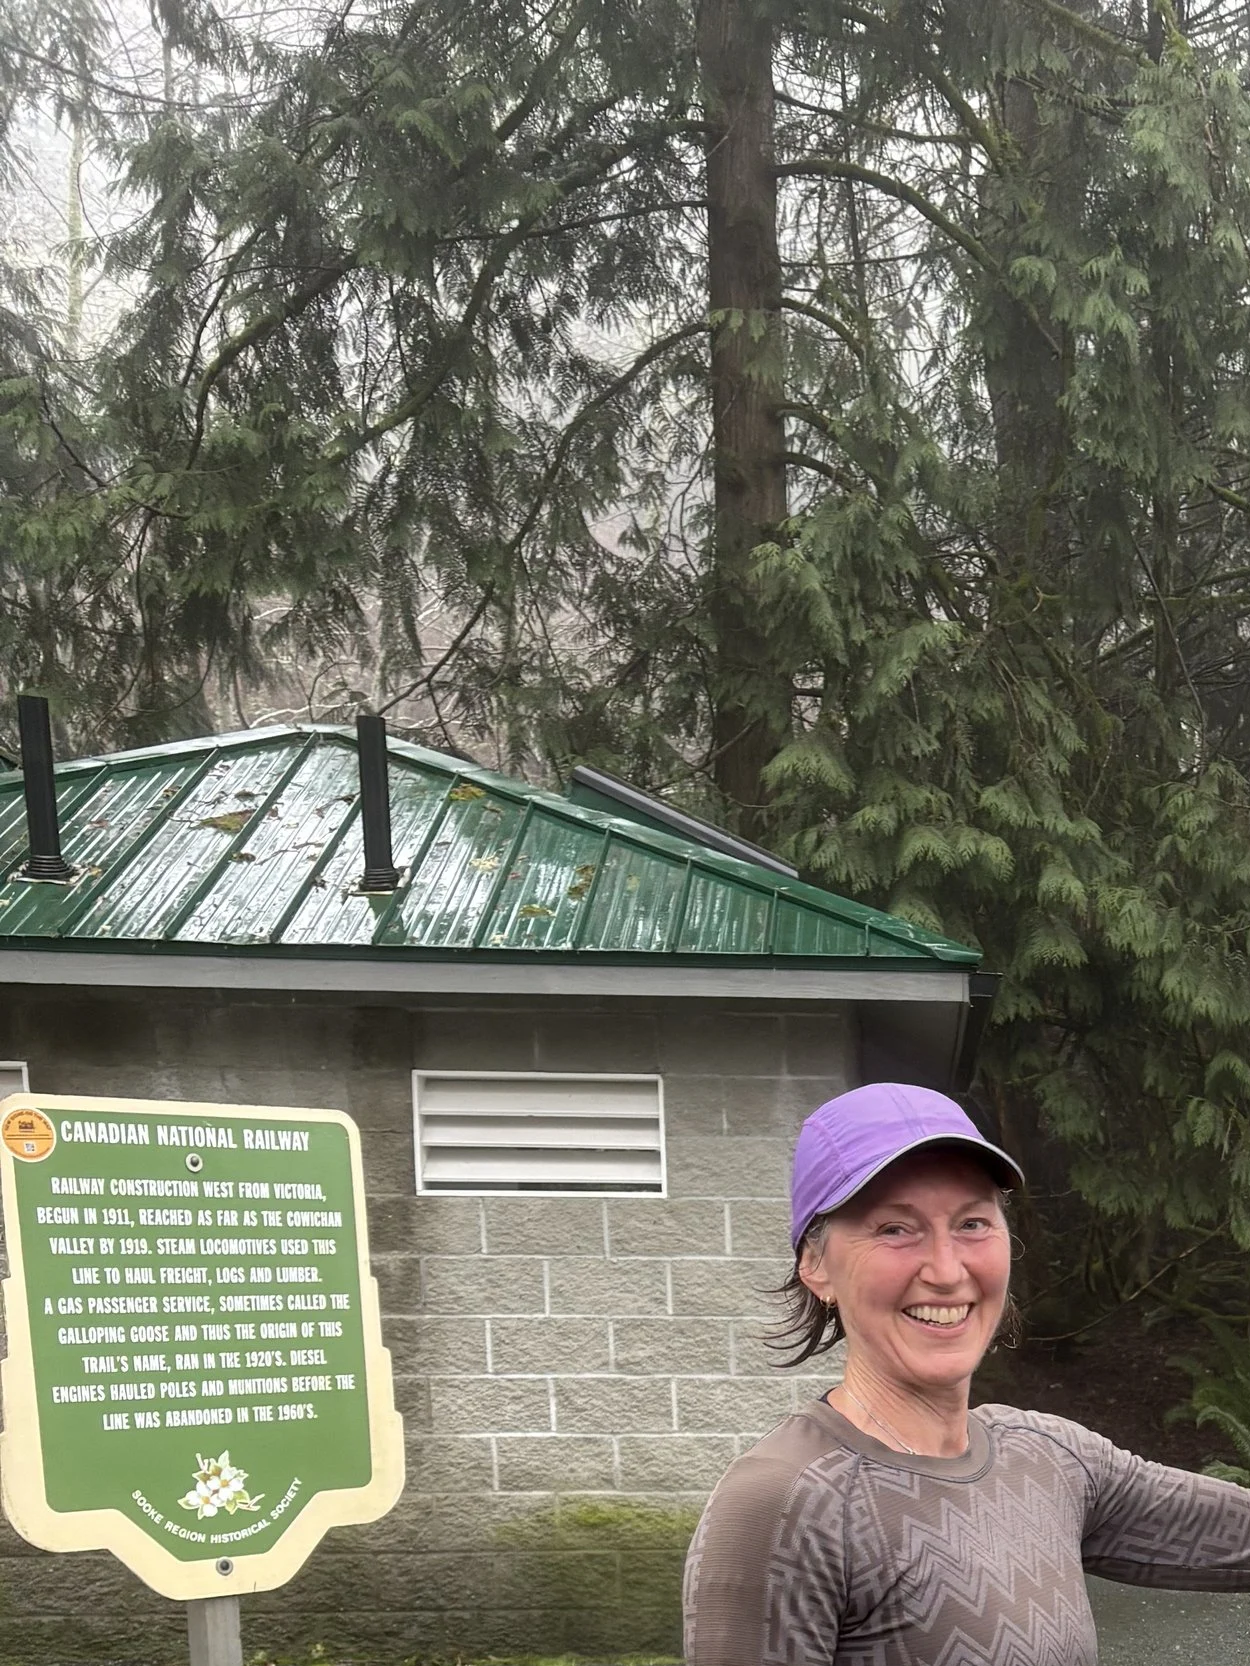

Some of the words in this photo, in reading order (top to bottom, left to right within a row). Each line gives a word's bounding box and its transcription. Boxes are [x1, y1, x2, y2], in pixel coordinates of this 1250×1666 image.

[61, 1121, 149, 1144] CANADIAN
[157, 1124, 237, 1148] NATIONAL
[243, 1127, 309, 1151] RAILWAY
[51, 1177, 104, 1194] RAILWAY
[110, 1179, 198, 1197] CONSTRUCTION
[203, 1182, 234, 1197] WEST
[239, 1182, 269, 1198] FROM
[274, 1183, 326, 1202] VICTORIA,
[37, 1207, 79, 1224] BEGUN
[84, 1208, 97, 1224] IN
[102, 1208, 134, 1227] 1911,
[139, 1209, 192, 1225] REACHED
[198, 1210, 212, 1226] AS
[217, 1210, 238, 1226] FAR
[243, 1211, 257, 1226] AS
[261, 1211, 283, 1226] THE
[287, 1211, 342, 1227] COWICHAN
[49, 1238, 94, 1254] VALLEY
[99, 1238, 114, 1254] BY
[120, 1238, 152, 1254] 1919.
[157, 1238, 196, 1254] STEAM
[200, 1239, 277, 1255] LOCOMOTIVES
[281, 1239, 308, 1254] USED
[312, 1239, 336, 1254] THIS
[72, 1268, 100, 1284] LINE
[104, 1268, 120, 1284] TO
[125, 1268, 156, 1284] HAUL
[160, 1267, 212, 1286] FREIGHT,
[216, 1267, 245, 1283] LOGS
[250, 1267, 272, 1282] AND
[276, 1267, 322, 1282] LUMBER.
[45, 1298, 53, 1314] A
[58, 1297, 83, 1314] GAS
[88, 1297, 158, 1313] PASSENGER
[163, 1296, 214, 1314] SERVICE,
[219, 1295, 283, 1312] SOMETIMES
[288, 1295, 326, 1310] CALLED
[330, 1294, 350, 1309] THE
[58, 1327, 125, 1344] GALLOPING
[130, 1326, 169, 1342] GOOSE
[175, 1325, 197, 1341] AND
[201, 1324, 231, 1340] THUS
[234, 1324, 256, 1339] THE
[260, 1323, 297, 1339] ORIGIN
[301, 1322, 315, 1337] OF
[318, 1321, 343, 1337] THIS
[82, 1356, 128, 1373] TRAIL'S
[133, 1355, 171, 1373] NAME,
[175, 1354, 199, 1370] RAN
[203, 1353, 215, 1369] IN
[219, 1352, 241, 1368] THE
[245, 1351, 286, 1367] 1920'S.
[290, 1349, 327, 1365] DIESEL
[52, 1385, 105, 1403] ENGINES
[110, 1383, 155, 1400] HAULED
[160, 1381, 196, 1398] POLES
[202, 1380, 224, 1396] AND
[229, 1377, 288, 1395] MUNITIONS
[292, 1376, 332, 1392] BEFORE
[335, 1374, 355, 1389] THE
[103, 1413, 130, 1430] LINE
[134, 1411, 160, 1428] WAS
[166, 1408, 232, 1427] ABANDONED
[237, 1407, 249, 1422] IN
[252, 1406, 273, 1421] THE
[278, 1404, 317, 1420] 1960'S.
[132, 1489, 162, 1525] SOOKE
[165, 1520, 206, 1543] REGION
[210, 1518, 270, 1544] HISTORICAL
[269, 1477, 303, 1521] SOCIETY
